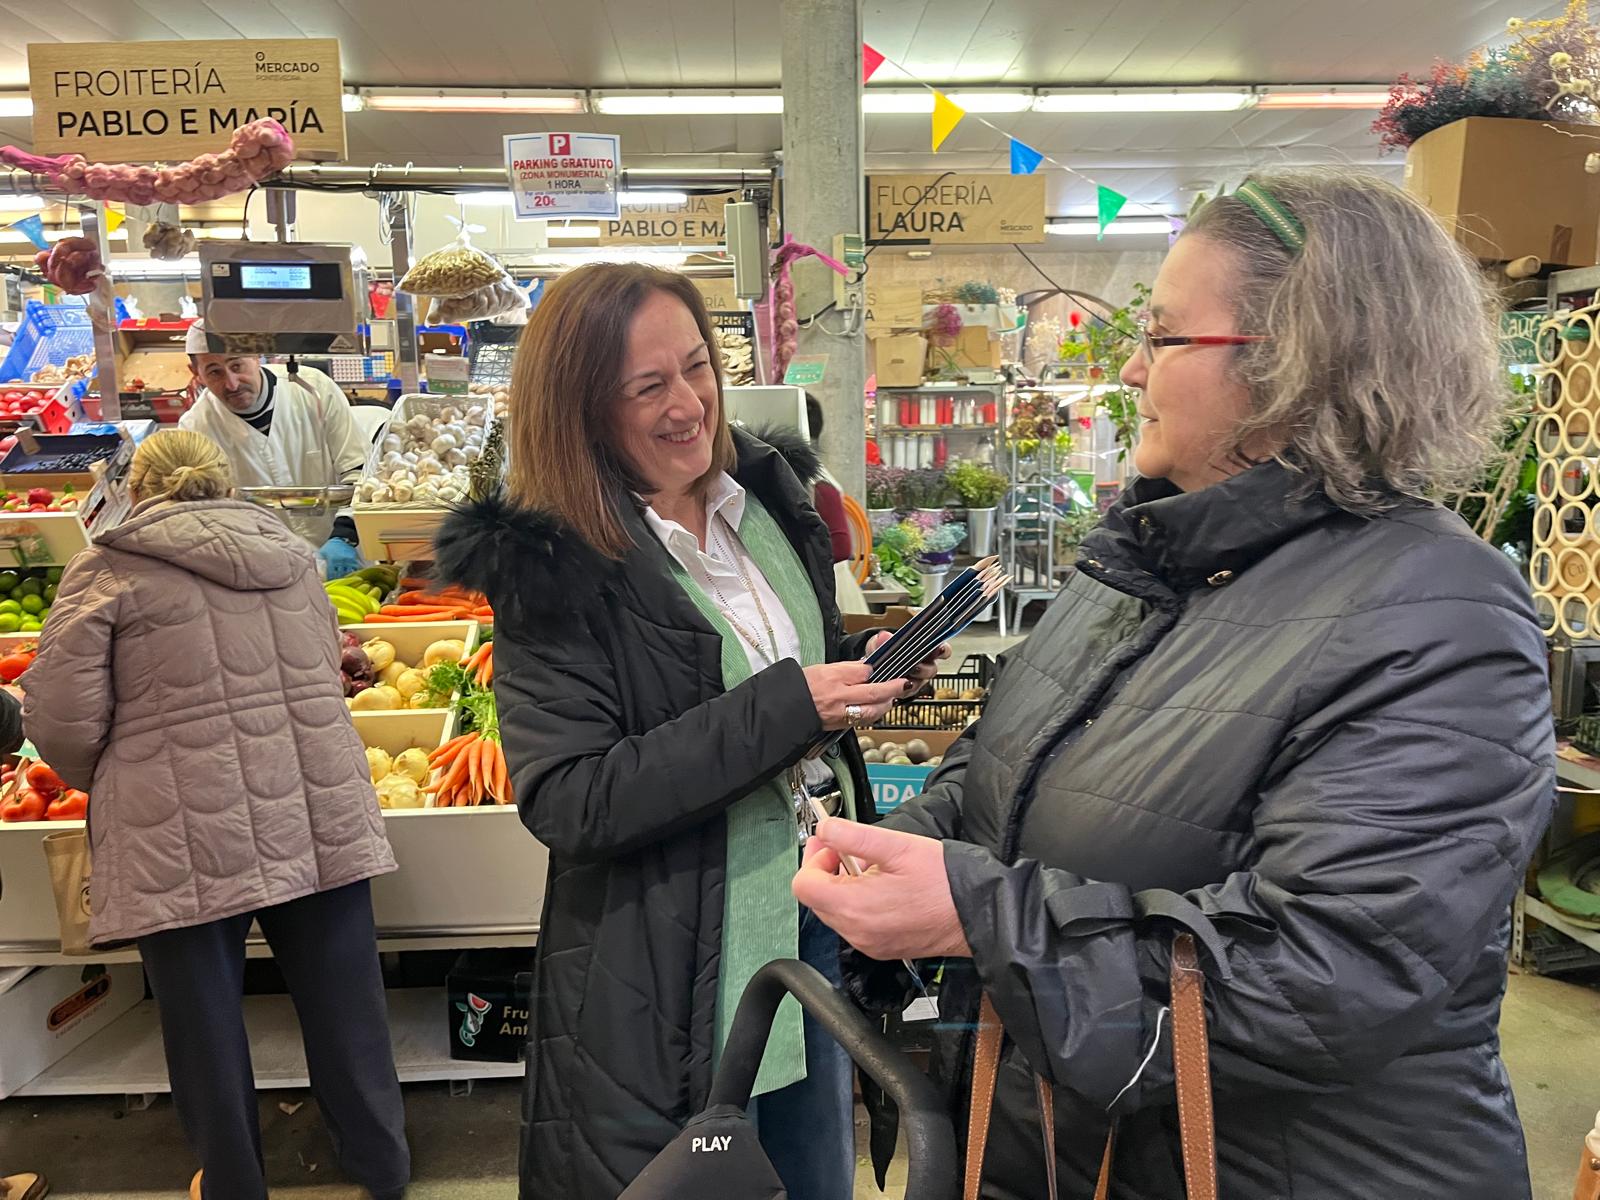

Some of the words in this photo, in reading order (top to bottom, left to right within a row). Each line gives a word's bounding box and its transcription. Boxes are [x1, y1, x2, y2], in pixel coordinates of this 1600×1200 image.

[255, 62, 320, 73] MERCADO
[54, 62, 226, 97] FROITERÍA
[57, 108, 169, 138] PABLO
[181, 108, 198, 134] E
[209, 100, 324, 134] MARÍA
[552, 136, 567, 154] P
[513, 159, 559, 170] PARKING
[561, 158, 614, 169] GRATUITO
[520, 172, 545, 180] (ZONA
[547, 170, 608, 180] MONUMENTAL)
[547, 181, 553, 189] 1
[554, 180, 582, 189] HORA
[877, 181, 994, 206] FLORERÍA
[534, 195, 557, 207] 20€
[608, 220, 678, 238] PABLO
[684, 220, 696, 237] E
[877, 211, 965, 233] LAURA
[691, 1135, 732, 1153] PLAY
